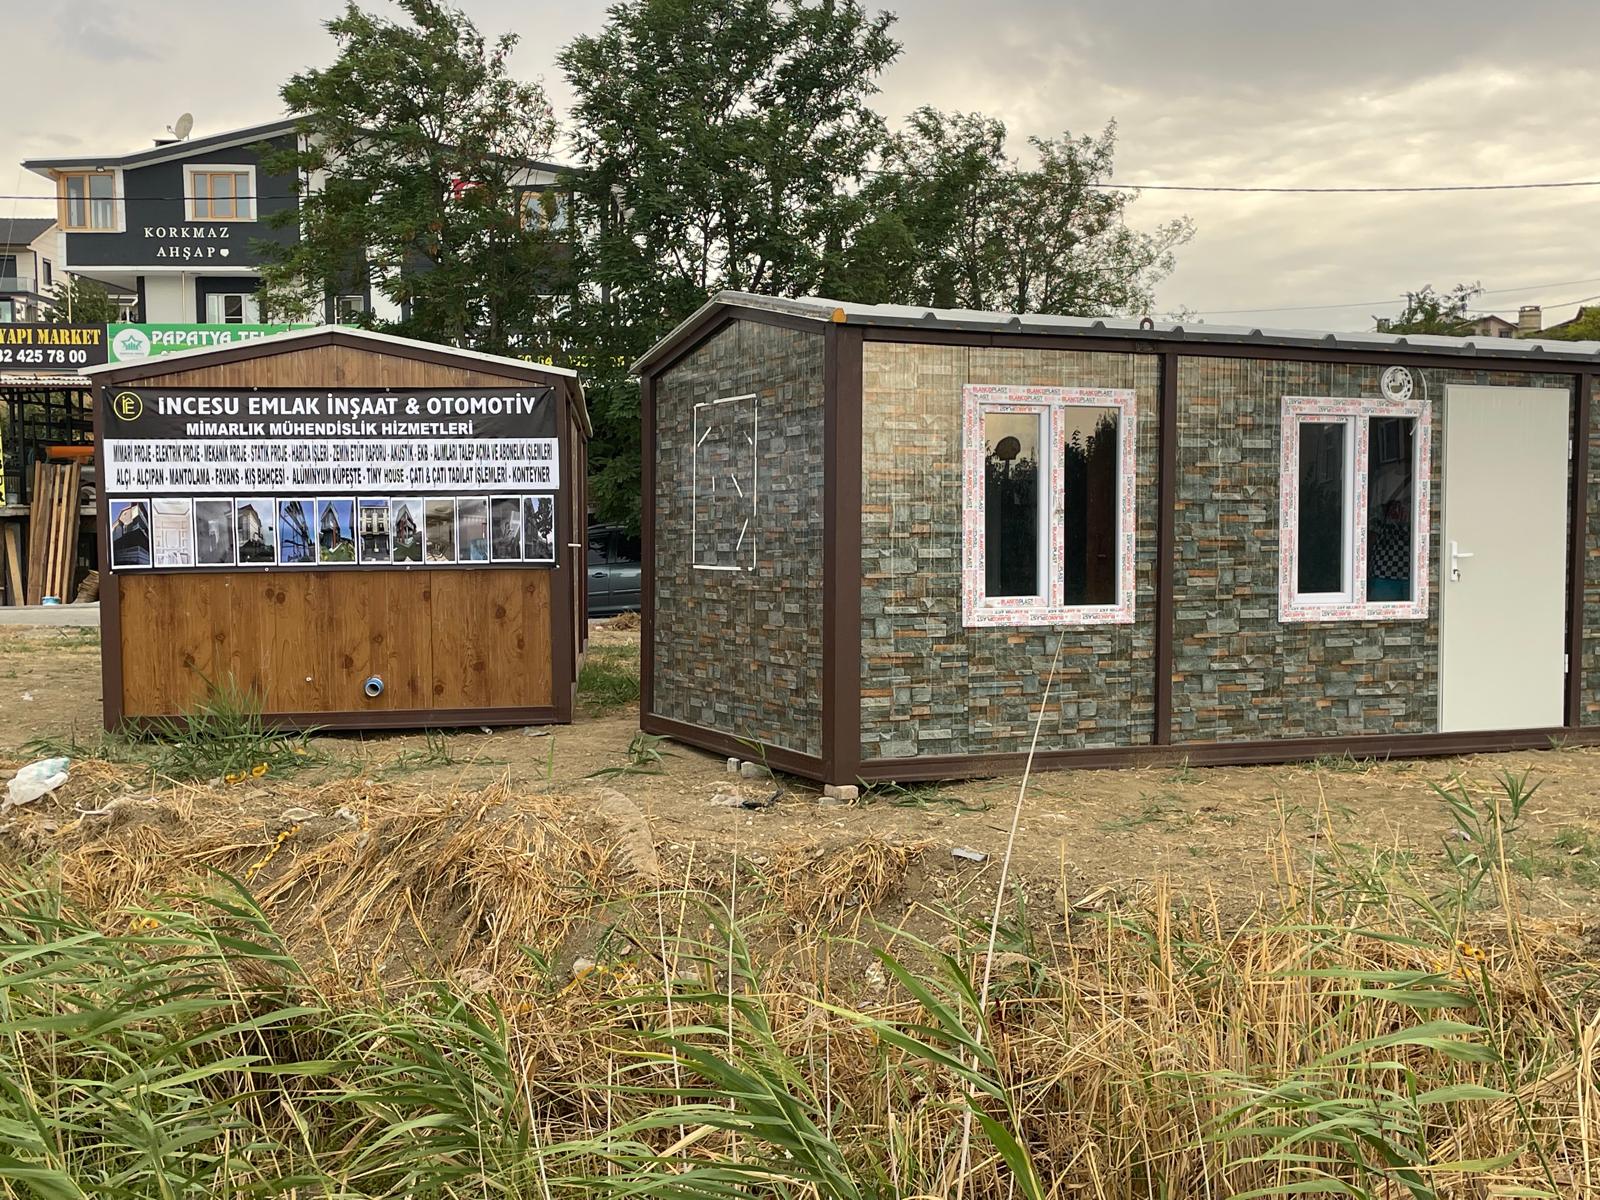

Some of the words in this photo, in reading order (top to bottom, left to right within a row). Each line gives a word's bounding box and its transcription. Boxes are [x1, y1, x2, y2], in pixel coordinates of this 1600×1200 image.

[144, 227, 229, 238] KORKMAZ
[156, 246, 216, 260] AHŞAP
[0, 328, 33, 345] YAPI
[37, 328, 101, 345] MARKET
[152, 330, 231, 345] PAPATYA
[17, 349, 43, 363] 425
[47, 350, 65, 363] 78
[69, 350, 87, 363] 00
[248, 397, 321, 415] EMLAK
[327, 392, 398, 420] İNŞAAT
[405, 397, 420, 415] &
[426, 392, 536, 415] OTOMOTİV
[186, 420, 265, 436] MİMARLIK
[269, 420, 378, 436] MÜHENDİSLİK
[381, 419, 474, 435] HİZMETLERİ
[134, 444, 151, 462] PROJE
[183, 444, 200, 462] PROJE
[230, 444, 246, 462] PROJE
[271, 444, 287, 462] PROJE
[418, 444, 428, 460] EKB
[459, 444, 474, 460] TALEP
[491, 444, 498, 460] VE
[117, 468, 131, 489] ALÇI
[137, 468, 164, 489] ALÇIPAN
[169, 468, 210, 485] MANTOLAMA
[215, 468, 239, 485] FAYANS
[245, 468, 255, 489] KIŞ
[384, 469, 404, 483] HOUSE
[410, 467, 424, 488] ÇATI
[426, 467, 430, 483] &
[432, 467, 446, 488] ÇATI
[513, 466, 550, 482] KONTEYNER
